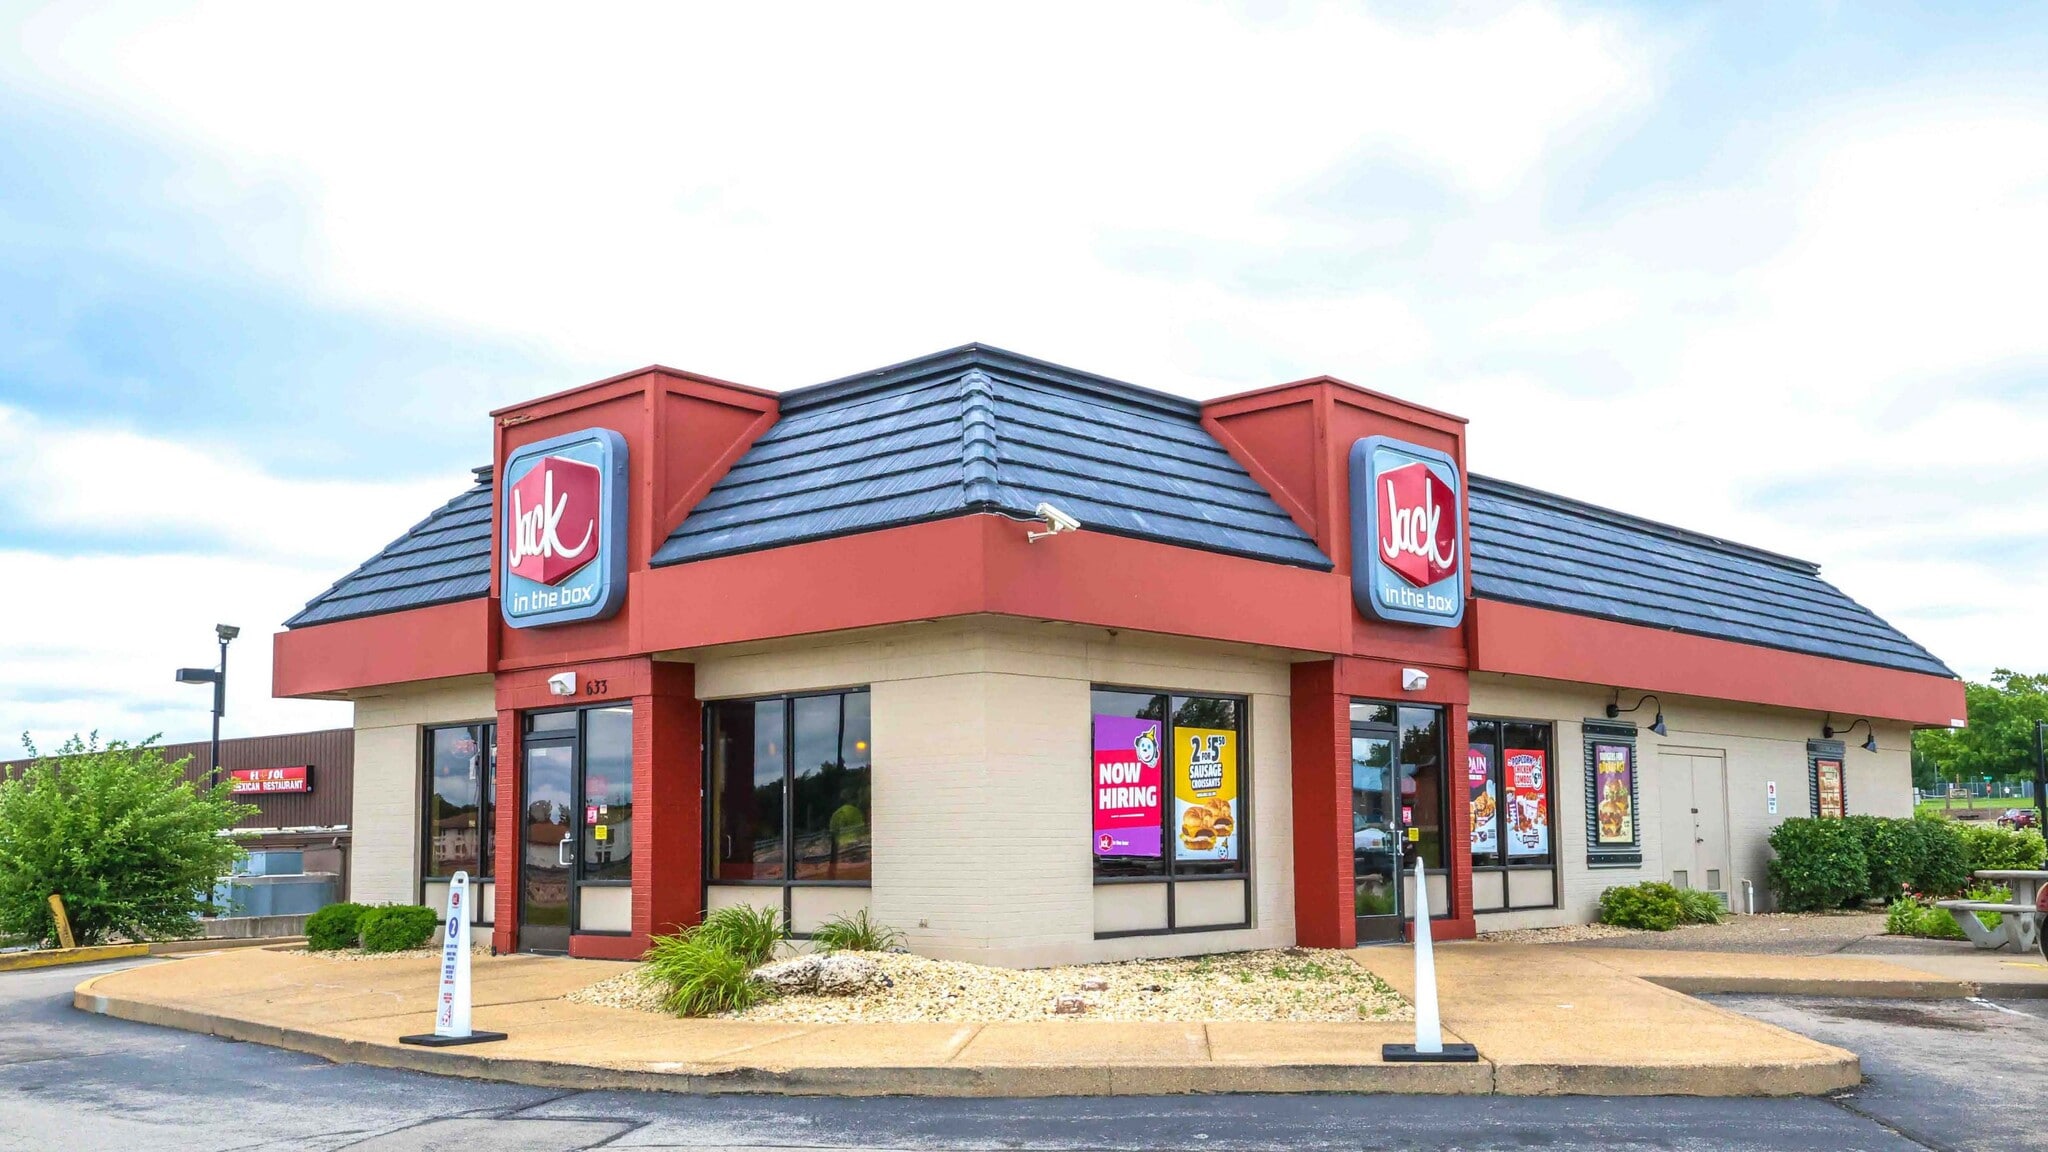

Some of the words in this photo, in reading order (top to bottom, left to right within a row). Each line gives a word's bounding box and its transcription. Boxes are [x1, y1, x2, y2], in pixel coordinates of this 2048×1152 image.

[510, 470, 593, 567] Jack
[1383, 478, 1455, 568] Jack
[514, 592, 528, 612] in
[532, 590, 557, 610] the
[561, 583, 595, 606] box
[1385, 584, 1399, 603] in
[1401, 587, 1425, 608] the
[1427, 590, 1453, 611] box
[586, 680, 607, 695] 633
[1191, 737, 1200, 762] 2
[1202, 752, 1211, 761] FOR
[267, 769, 284, 779] SOL
[1099, 762, 1142, 785] NOW
[1190, 763, 1222, 779] SAUSAGE
[263, 780, 303, 791] RESTAURANT
[1192, 777, 1220, 789] CROISSANTS
[1099, 786, 1157, 810] HIRING
